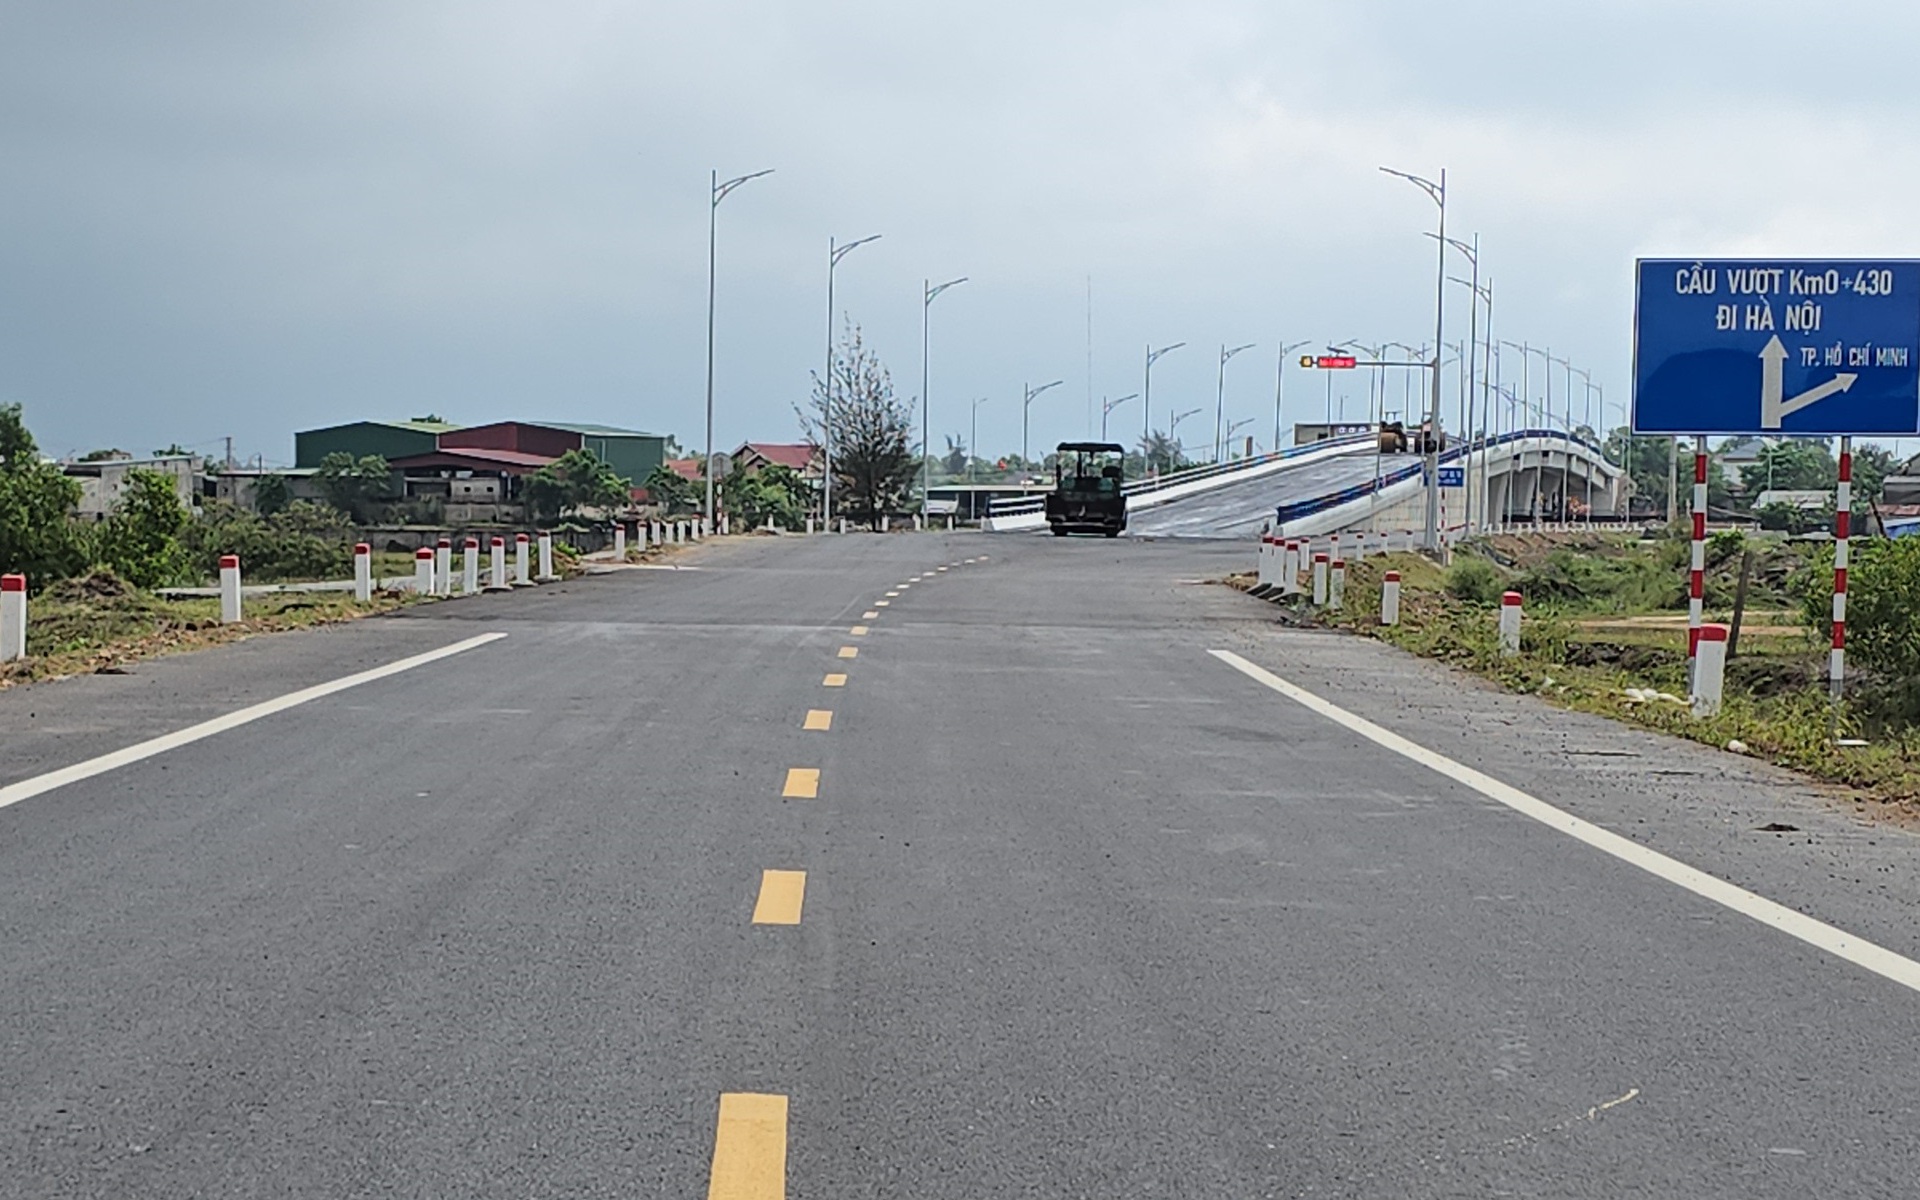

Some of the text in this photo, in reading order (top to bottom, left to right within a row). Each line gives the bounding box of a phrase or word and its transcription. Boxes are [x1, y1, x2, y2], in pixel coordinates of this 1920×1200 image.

[1676, 262, 1716, 294] CẦU
[1728, 268, 1783, 298] VƯỢT
[1716, 297, 1822, 335] ĐI HÀ NỘI
[1800, 347, 1820, 366] TP.
[1849, 342, 1871, 366] CHÍ
[1876, 347, 1908, 366] MINH
